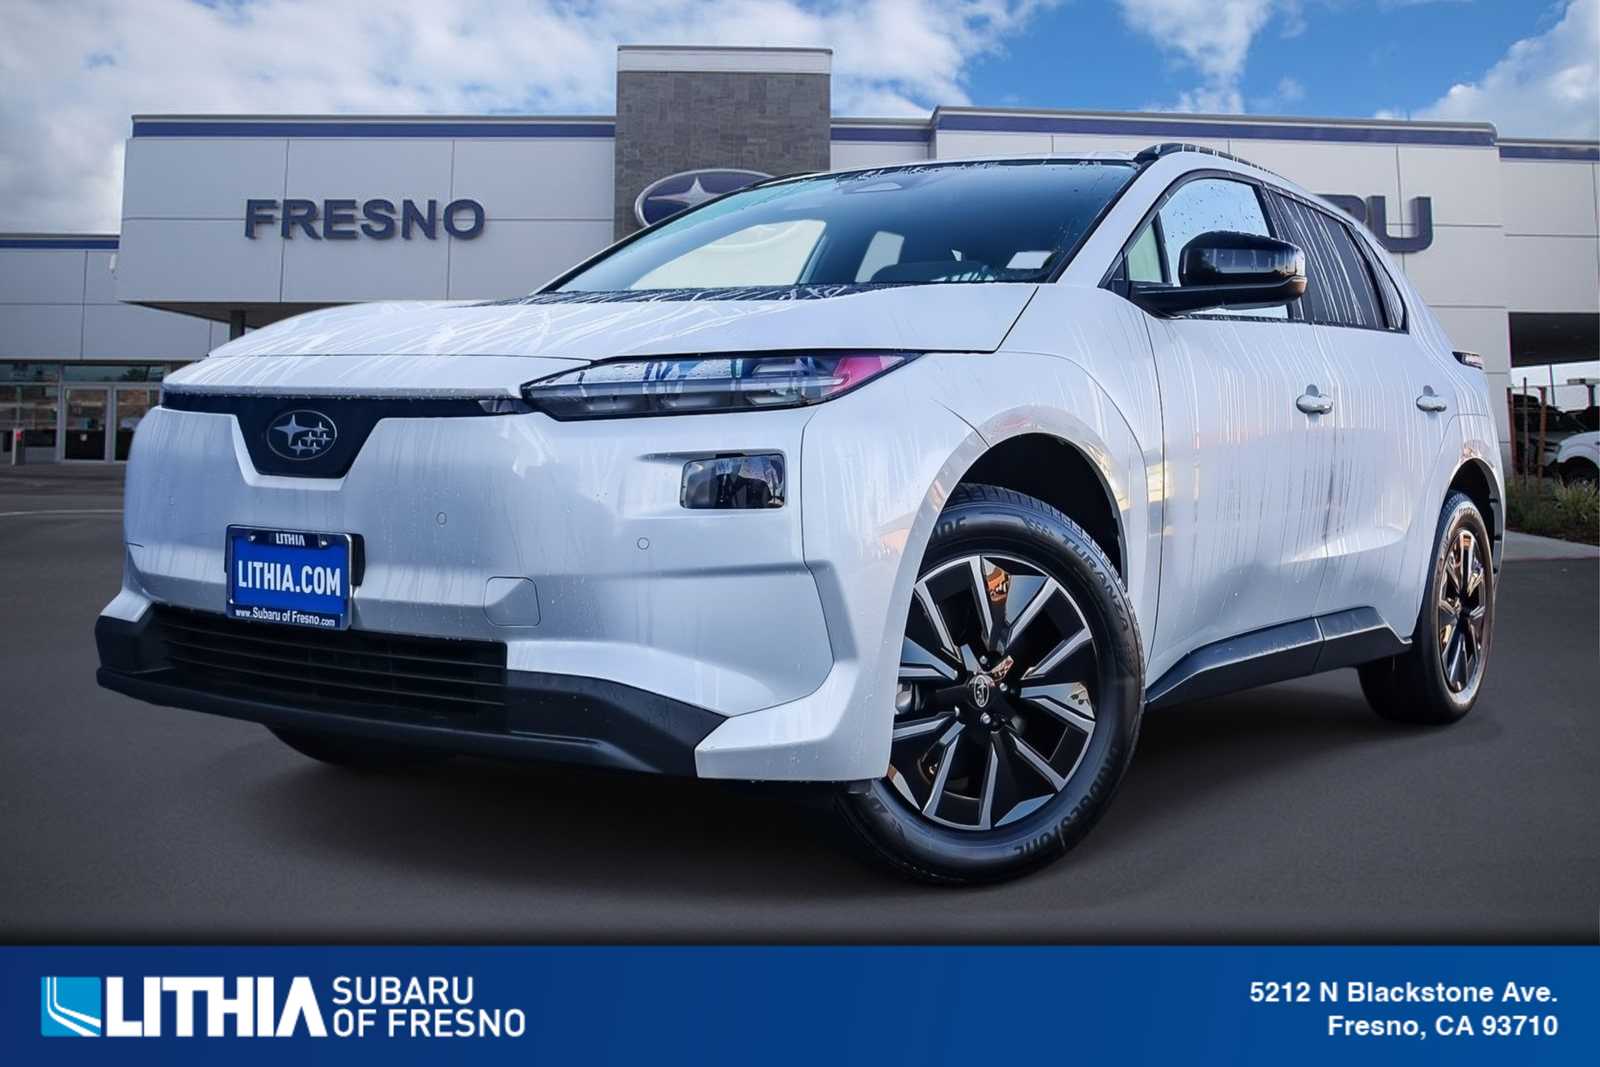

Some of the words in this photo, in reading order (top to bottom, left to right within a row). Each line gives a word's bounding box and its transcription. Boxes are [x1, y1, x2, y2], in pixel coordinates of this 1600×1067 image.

[244, 199, 486, 240] FRESNO
[275, 532, 306, 546] LITHIA
[238, 560, 340, 597] LITHIA.COM
[1060, 533, 1129, 632] TURANZA
